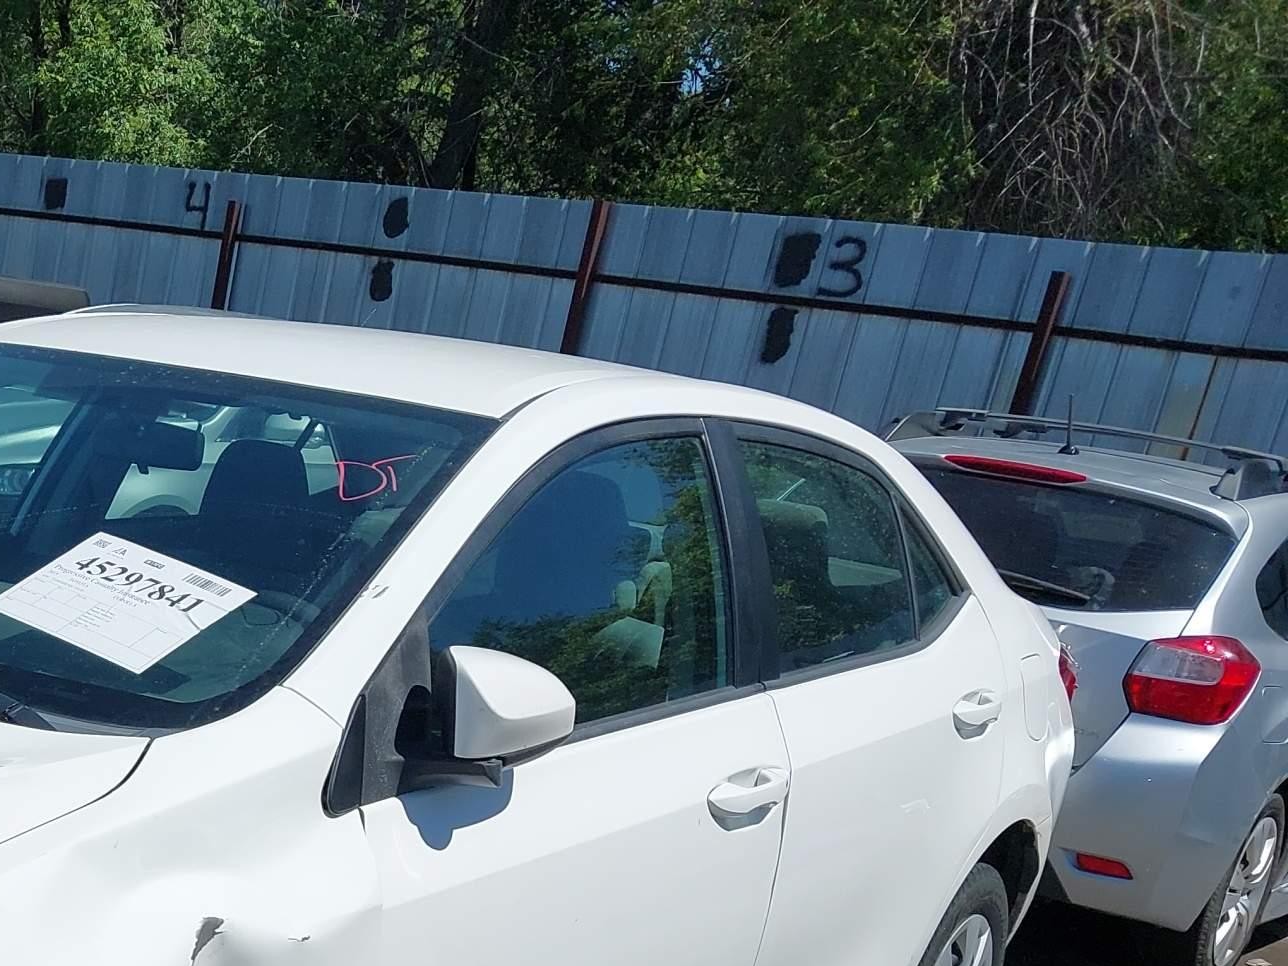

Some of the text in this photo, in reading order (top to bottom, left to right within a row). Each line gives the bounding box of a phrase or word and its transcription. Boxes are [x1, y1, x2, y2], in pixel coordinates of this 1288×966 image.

[185, 181, 212, 230] 4
[816, 235, 867, 298] 3
[75, 556, 205, 613] 45297841
